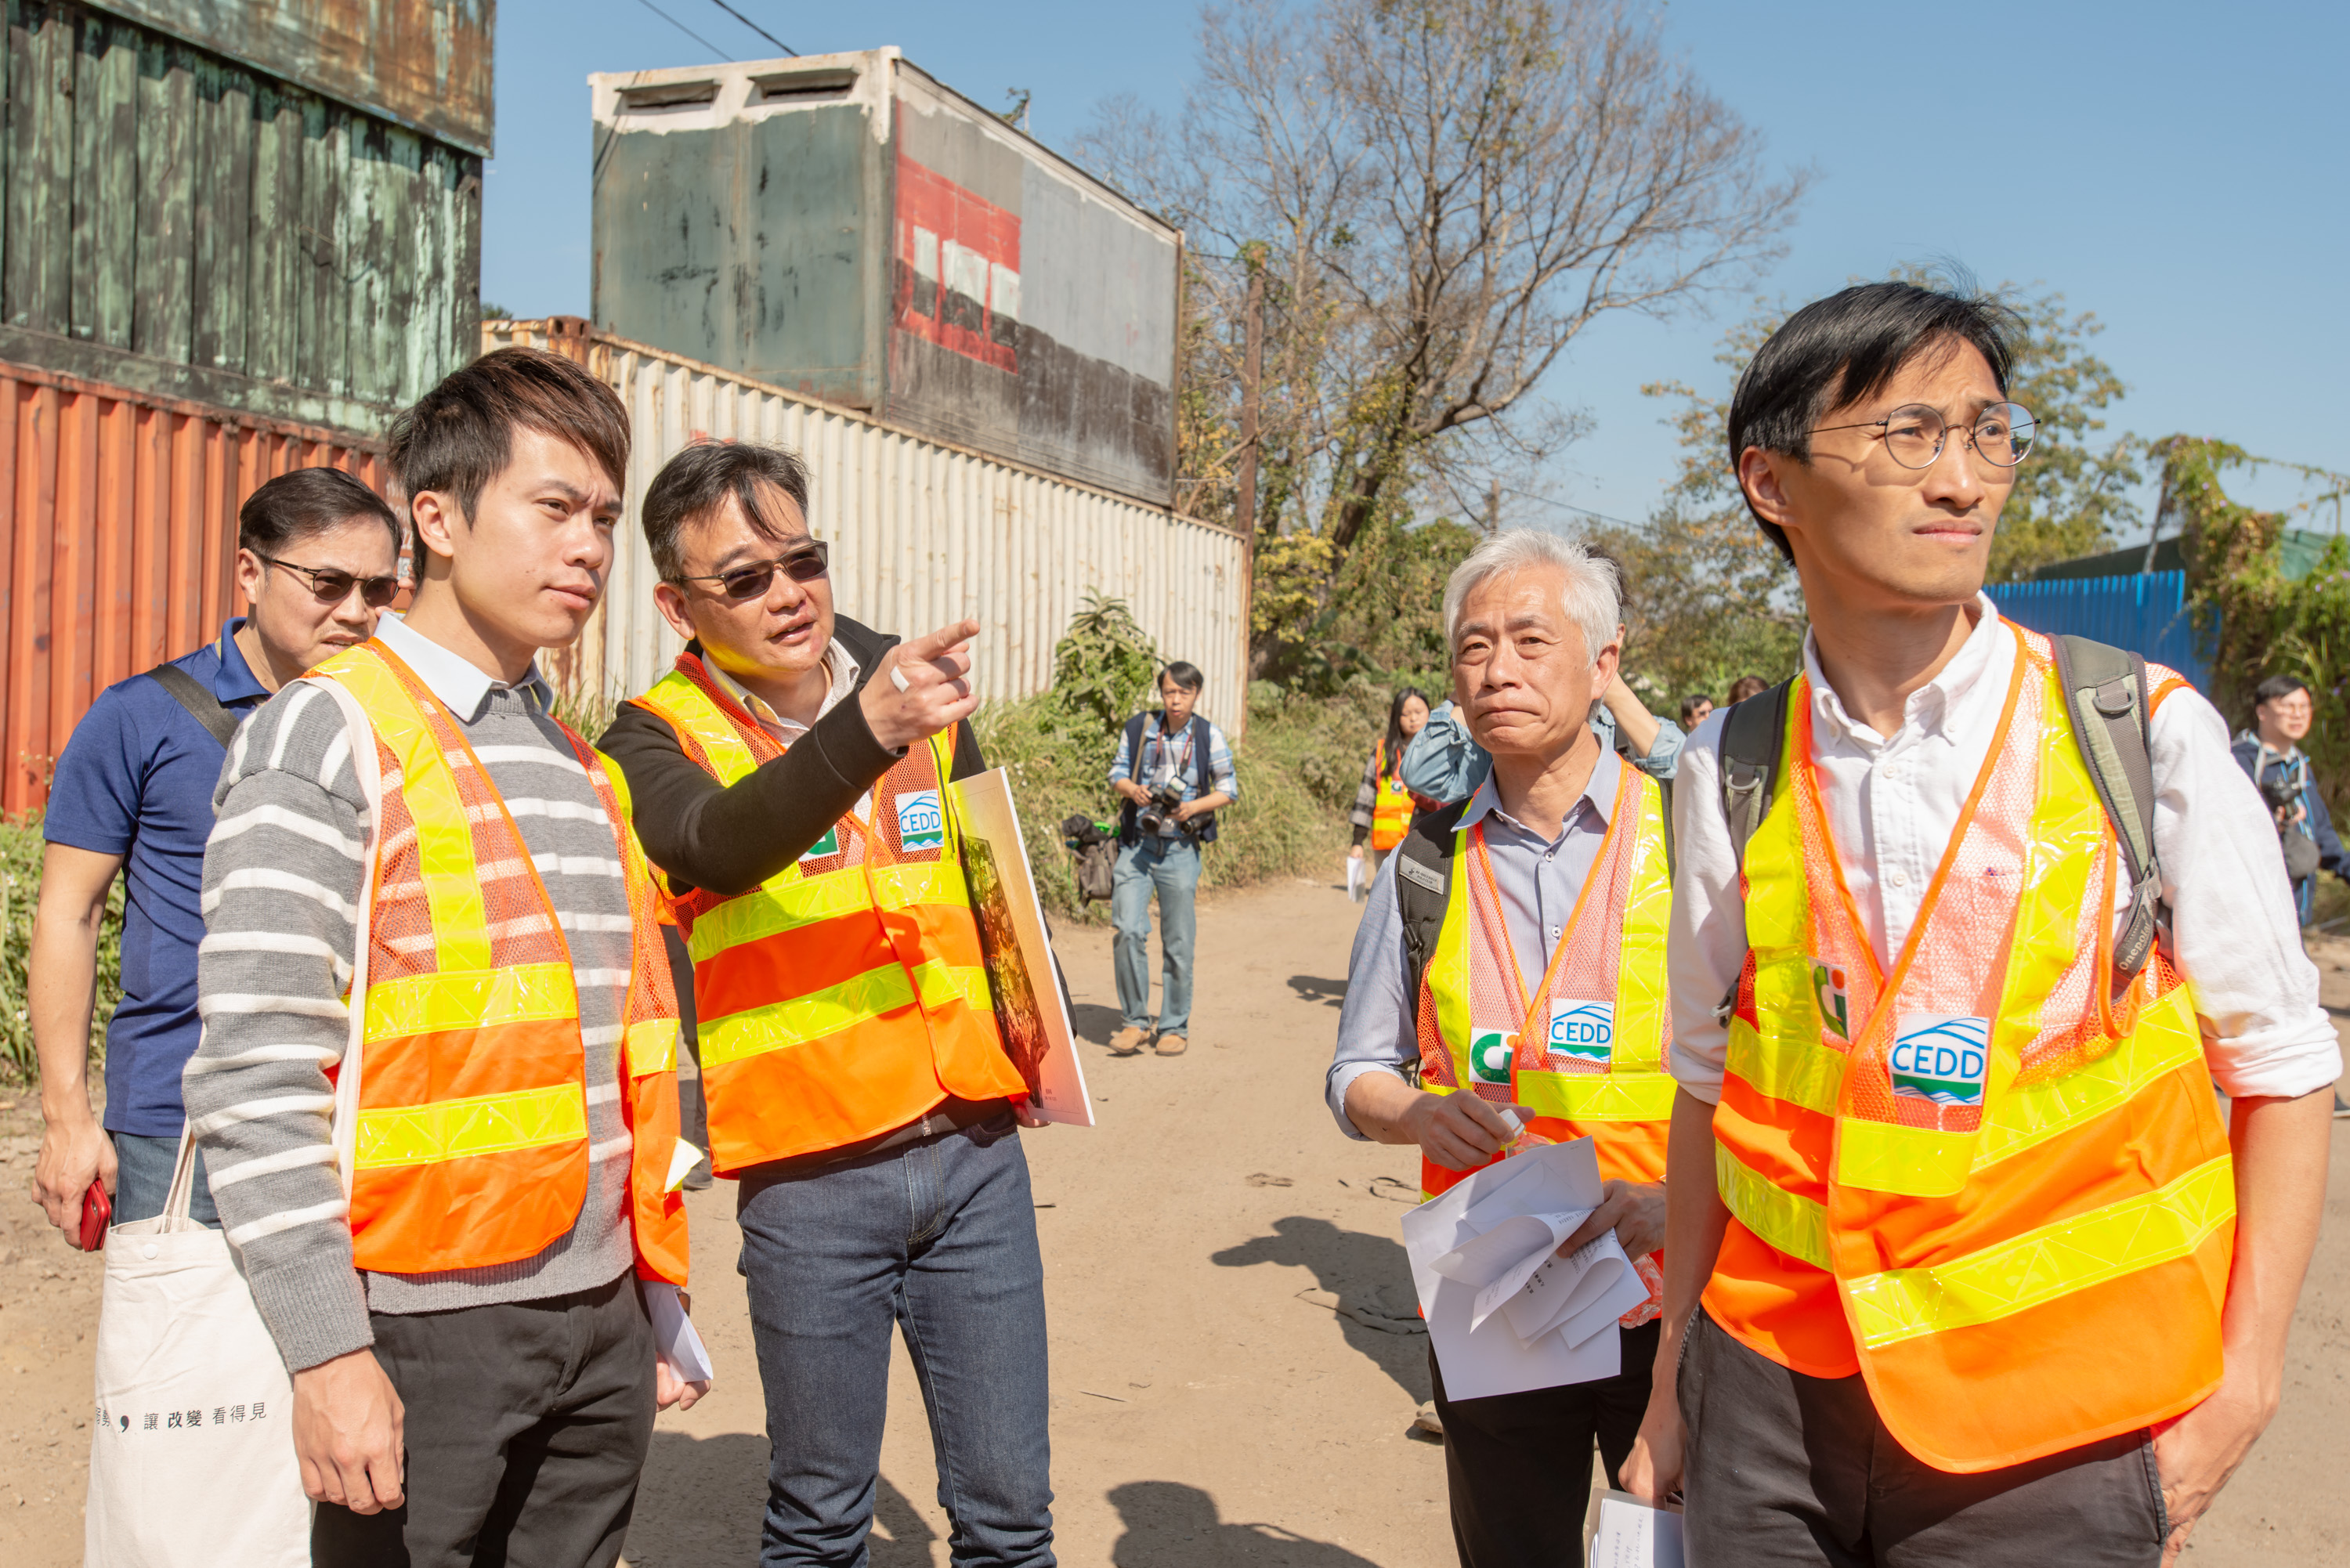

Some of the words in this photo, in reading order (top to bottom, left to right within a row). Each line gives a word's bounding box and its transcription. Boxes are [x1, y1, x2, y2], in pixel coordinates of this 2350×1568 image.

[900, 811, 941, 833] CEDD
[1551, 1021, 1611, 1043] CEDD
[1892, 1043, 1983, 1078] CEDD
[143, 1413, 159, 1430] 讓
[168, 1410, 202, 1429] 改變
[212, 1402, 267, 1425] 看得見
